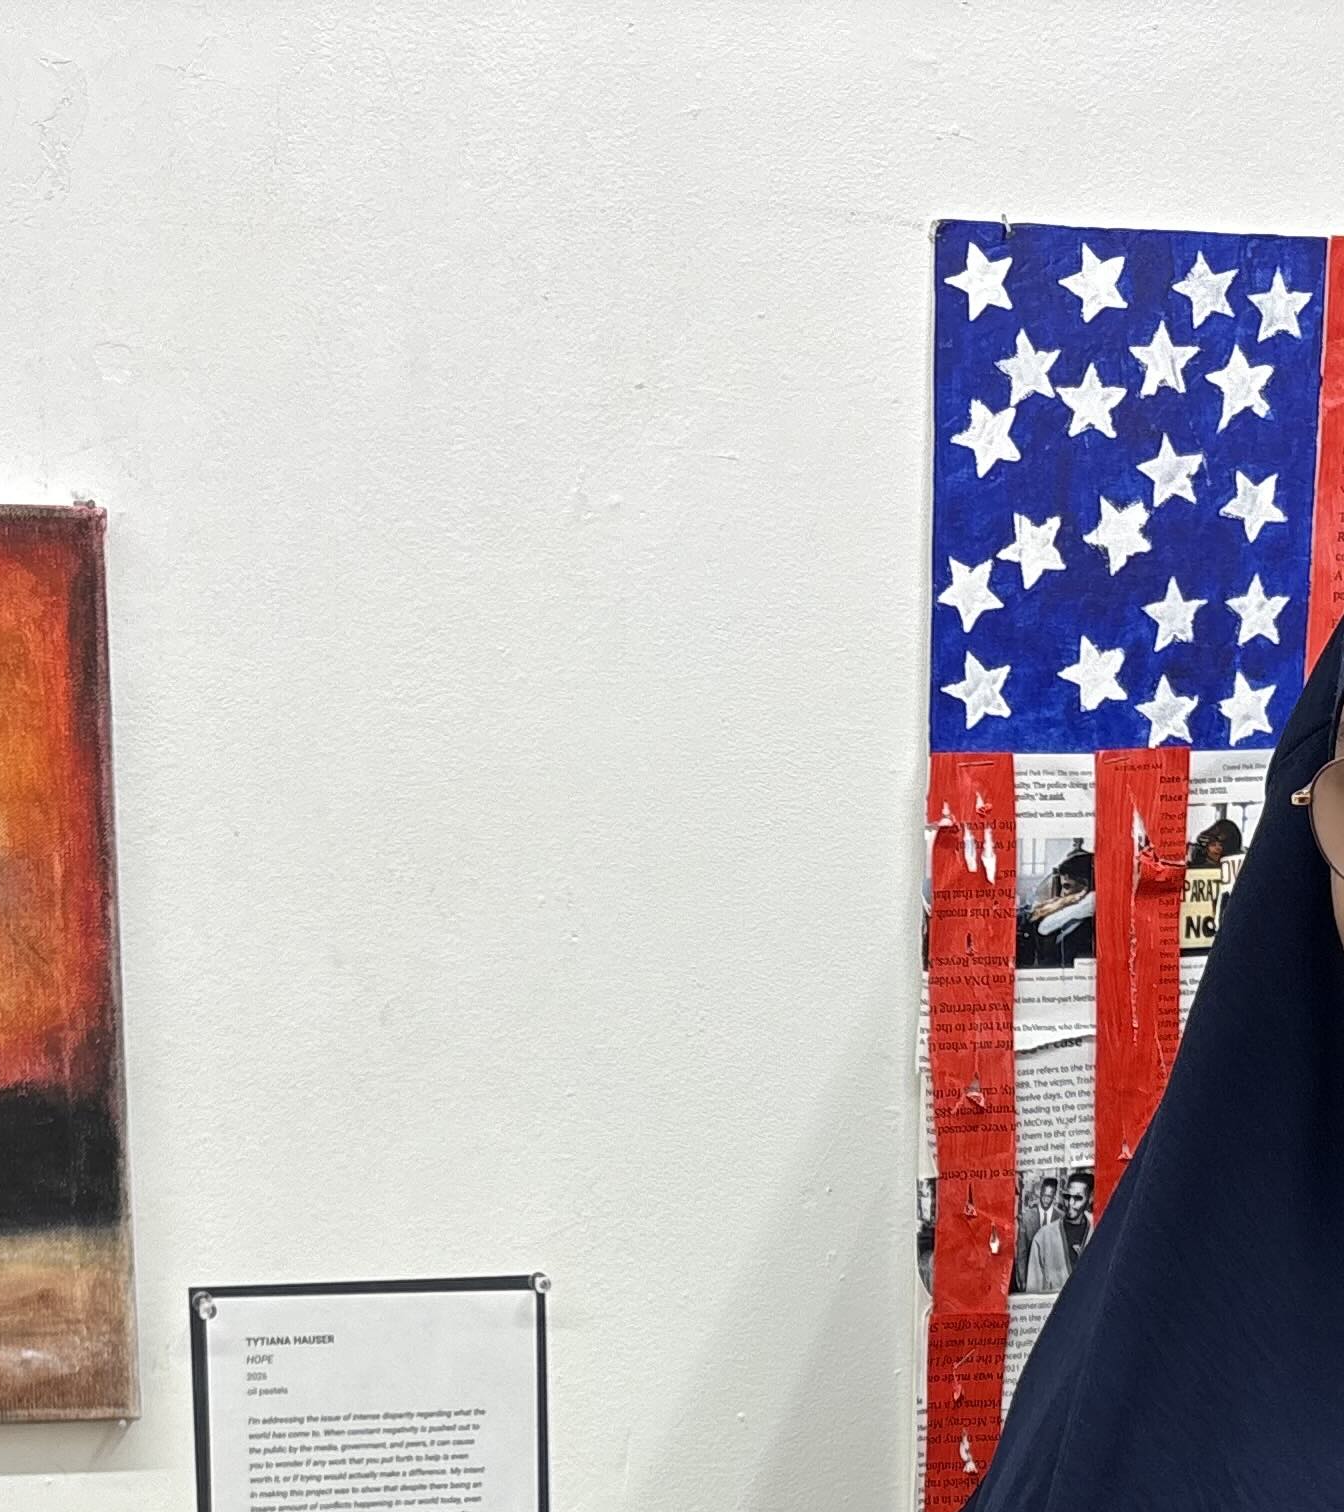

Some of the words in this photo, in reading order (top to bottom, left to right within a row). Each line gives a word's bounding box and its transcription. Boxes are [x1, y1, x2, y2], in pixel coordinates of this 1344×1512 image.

[964, 975, 990, 987] DNA
[938, 1003, 987, 1015] referring
[989, 1003, 1010, 1013] was
[938, 1041, 968, 1052] when
[1060, 1065, 1069, 1073] to
[1070, 1064, 1083, 1072] the
[246, 1336, 291, 1346] TYTIANA
[294, 1335, 334, 1344] HAUSER
[246, 1354, 273, 1364] HOPE
